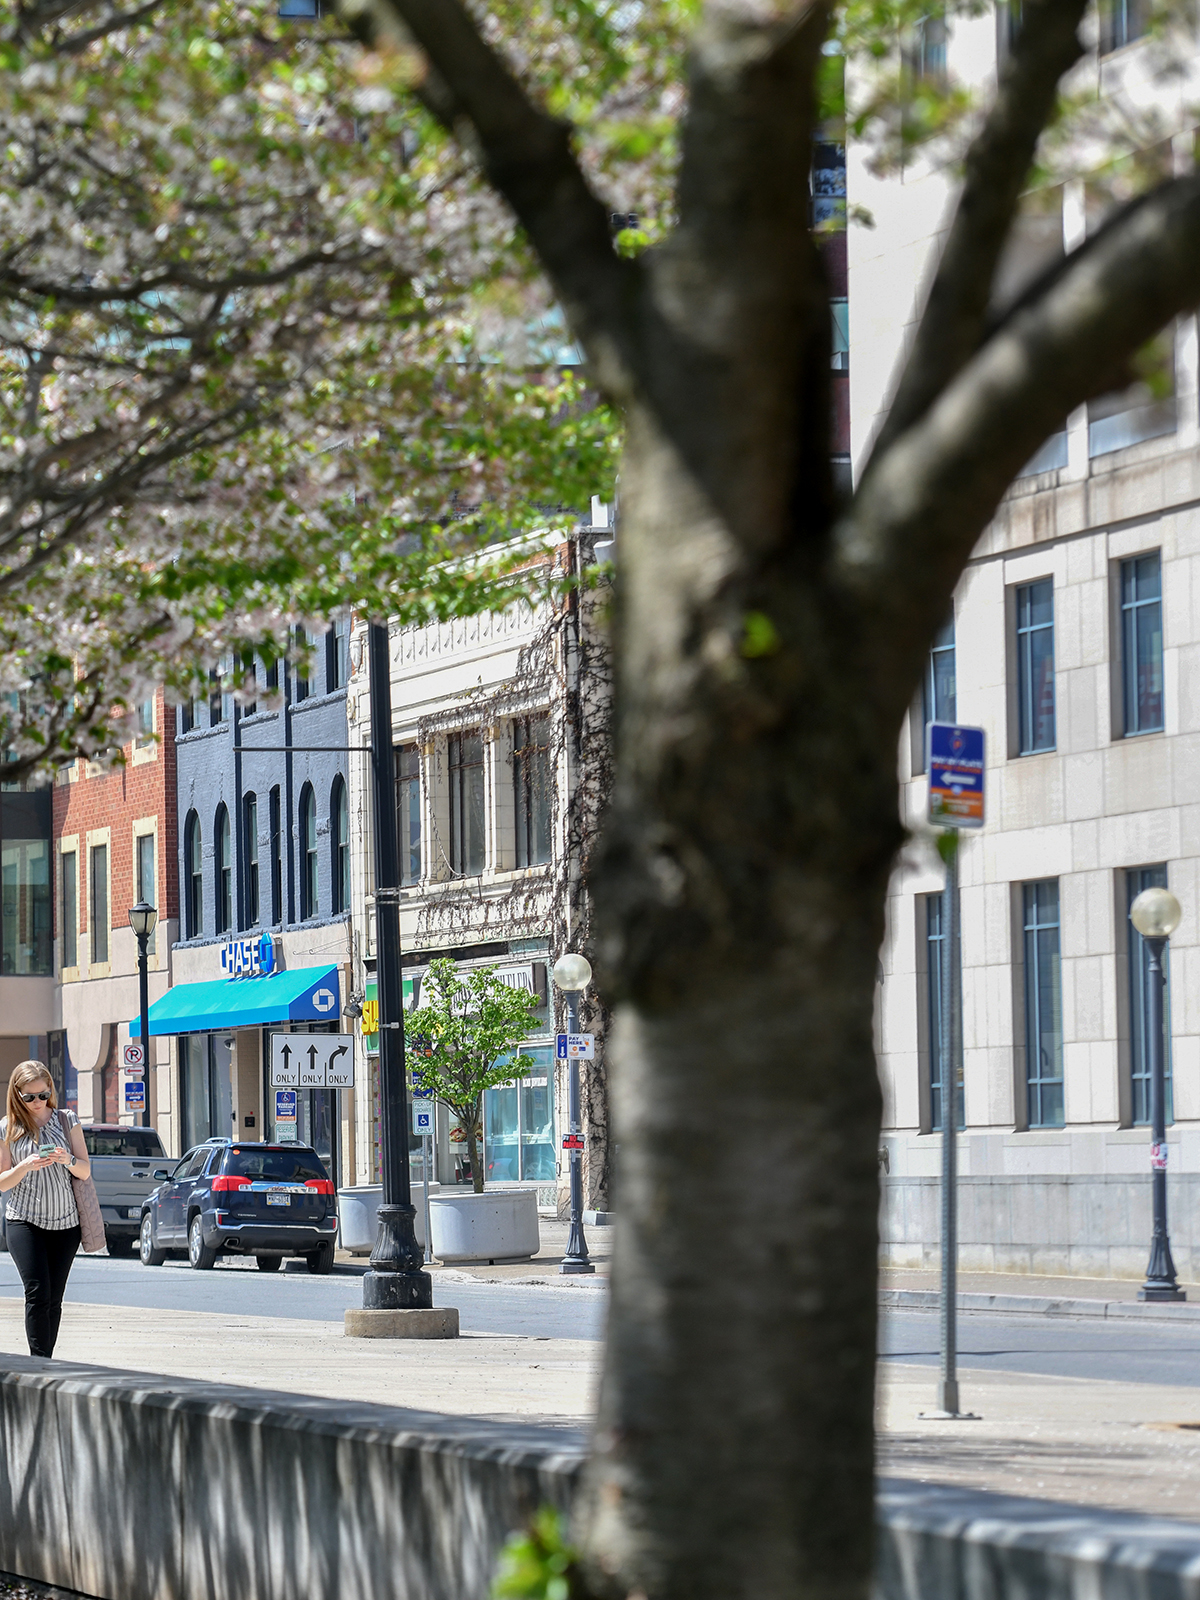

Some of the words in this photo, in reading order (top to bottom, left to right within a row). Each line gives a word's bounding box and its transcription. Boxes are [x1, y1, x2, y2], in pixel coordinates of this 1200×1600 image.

[220, 940, 261, 974] CHASE
[361, 1000, 379, 1034] SU
[276, 1074, 296, 1083] ONLY
[302, 1075, 322, 1083] ONLY
[329, 1075, 348, 1083] ONLY
